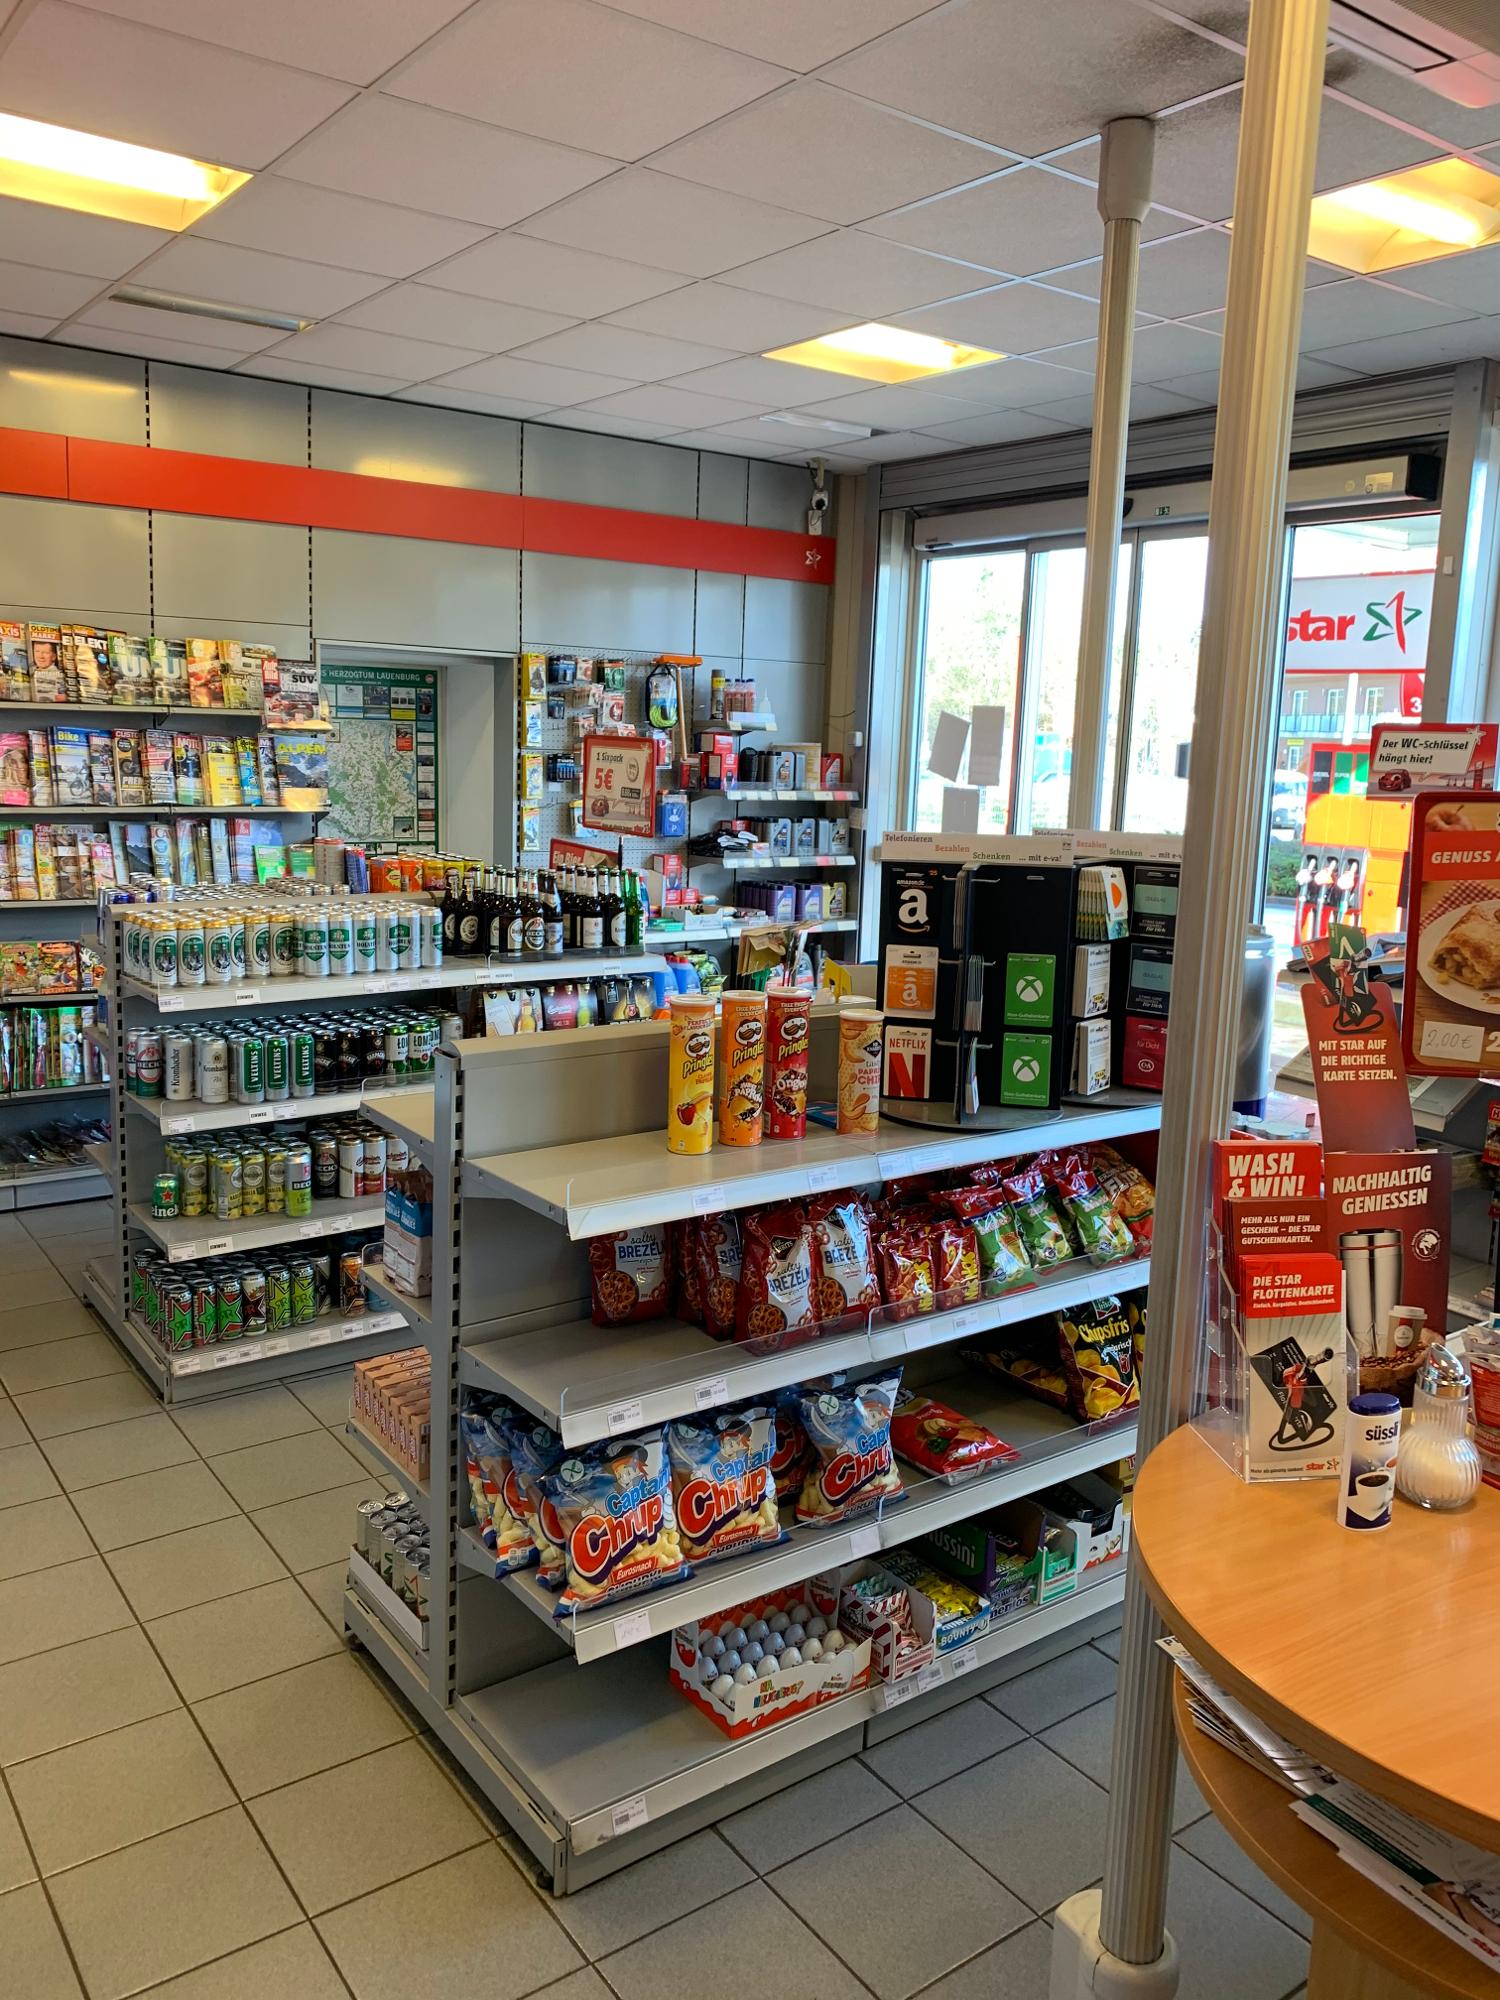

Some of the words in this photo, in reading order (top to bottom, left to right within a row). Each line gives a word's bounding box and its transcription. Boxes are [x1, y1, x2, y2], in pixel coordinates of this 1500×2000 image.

[329, 671, 375, 680] HERZOGTUM
[376, 672, 421, 682] LAUENBURG
[57, 731, 79, 742] Bike
[1382, 739, 1398, 748] Der
[1401, 737, 1469, 751] WC-Schlüssel
[1378, 753, 1407, 764] hängt
[1409, 753, 1433, 764] hier!
[594, 768, 614, 791] 5€
[885, 833, 934, 843] Telefonieren
[934, 844, 971, 853] Bezahlen
[972, 852, 1012, 861] Schenken
[1028, 854, 1041, 862] mit
[1076, 840, 1107, 849] Bezahlen
[1109, 848, 1143, 857] Schenken
[566, 854, 583, 866] Bier
[1431, 850, 1492, 864] GENUSS
[778, 1038, 809, 1062] Pringles
[889, 1038, 927, 1050] NETFLIX
[1319, 1040, 1338, 1050] MIT
[1340, 1040, 1365, 1050] STAR
[1367, 1039, 1387, 1050] AUF
[273, 1047, 282, 1079] VELTINS
[302, 1045, 311, 1076] VELTINS
[733, 1040, 764, 1069] Pringles
[1321, 1055, 1339, 1066] DIE
[1341, 1055, 1387, 1066] RICHTIGE
[250, 1050, 259, 1083] VELTINS
[683, 1055, 713, 1080] Pringles
[1323, 1070, 1356, 1081] KARTE
[1358, 1069, 1398, 1081] SETZEN.
[1228, 1152, 1295, 1177] WASH
[1228, 1178, 1246, 1198] &
[1250, 1175, 1305, 1198] WIN!
[1332, 1165, 1433, 1195] NACHHALTIG
[1342, 1188, 1428, 1216] GENIESSEN
[1241, 1215, 1263, 1224] MEHR
[1279, 1215, 1296, 1223] NUR
[1297, 1214, 1311, 1222] EIN
[1241, 1226, 1279, 1234] GESCHENK
[1241, 1235, 1313, 1245] GUTSCHEINKARTEN.
[1253, 1275, 1272, 1287] DIE
[1274, 1275, 1302, 1286] STAR
[1253, 1285, 1335, 1300] FLOTTENKARTE
[1305, 1463, 1326, 1471] star
[605, 1466, 669, 1517] Captain
[570, 1494, 664, 1578] Chrup
[616, 1561, 653, 1580] Eurosnack
[940, 1624, 977, 1647] BOUNTY
